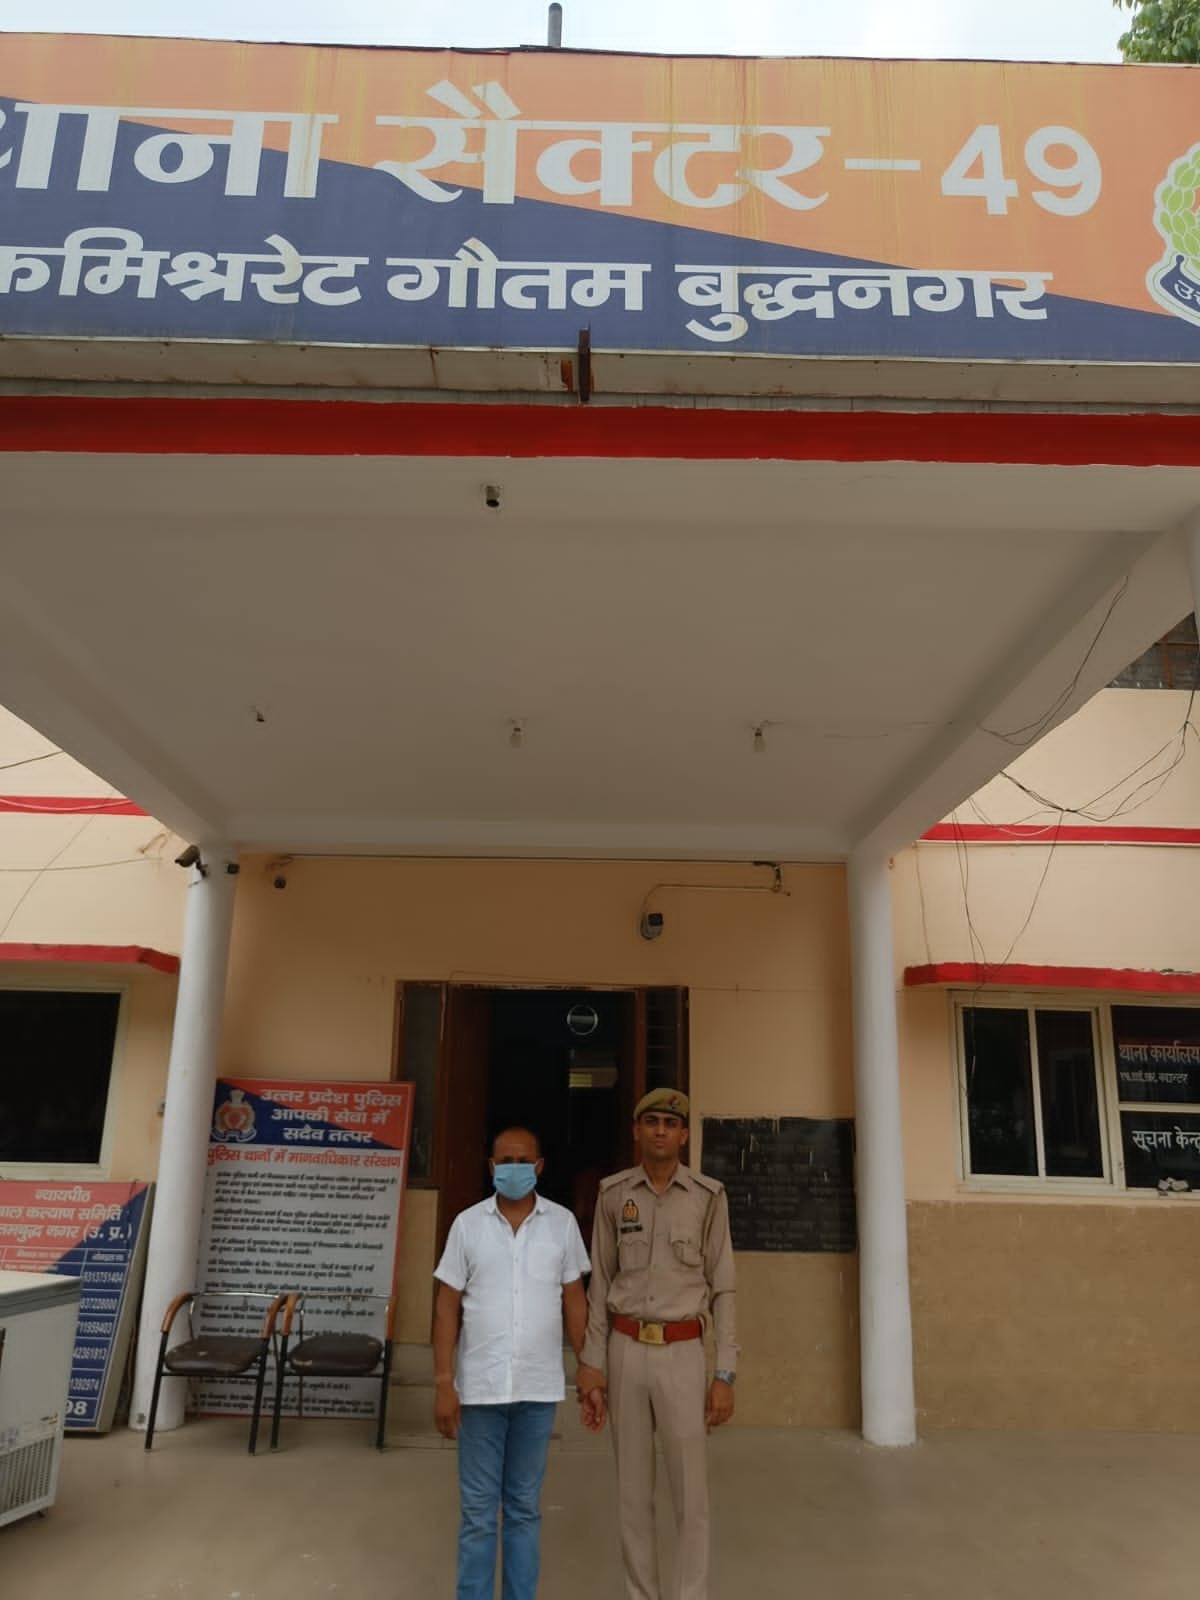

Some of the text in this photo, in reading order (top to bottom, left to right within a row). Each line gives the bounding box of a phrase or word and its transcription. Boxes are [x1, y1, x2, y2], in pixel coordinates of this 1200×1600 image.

[386, 237, 652, 312] गौतम
[675, 264, 1054, 343] बुद्धनगर
[260, 1088, 402, 1111] उत्तर प्रदेश पुलिस
[271, 1106, 391, 1125] आपकी सेवा में
[283, 1124, 374, 1143] सदैव तत्पर
[1131, 1130, 1172, 1153] सूचना
[26, 1207, 76, 1220] कल्याण
[79, 1203, 122, 1221] समिति
